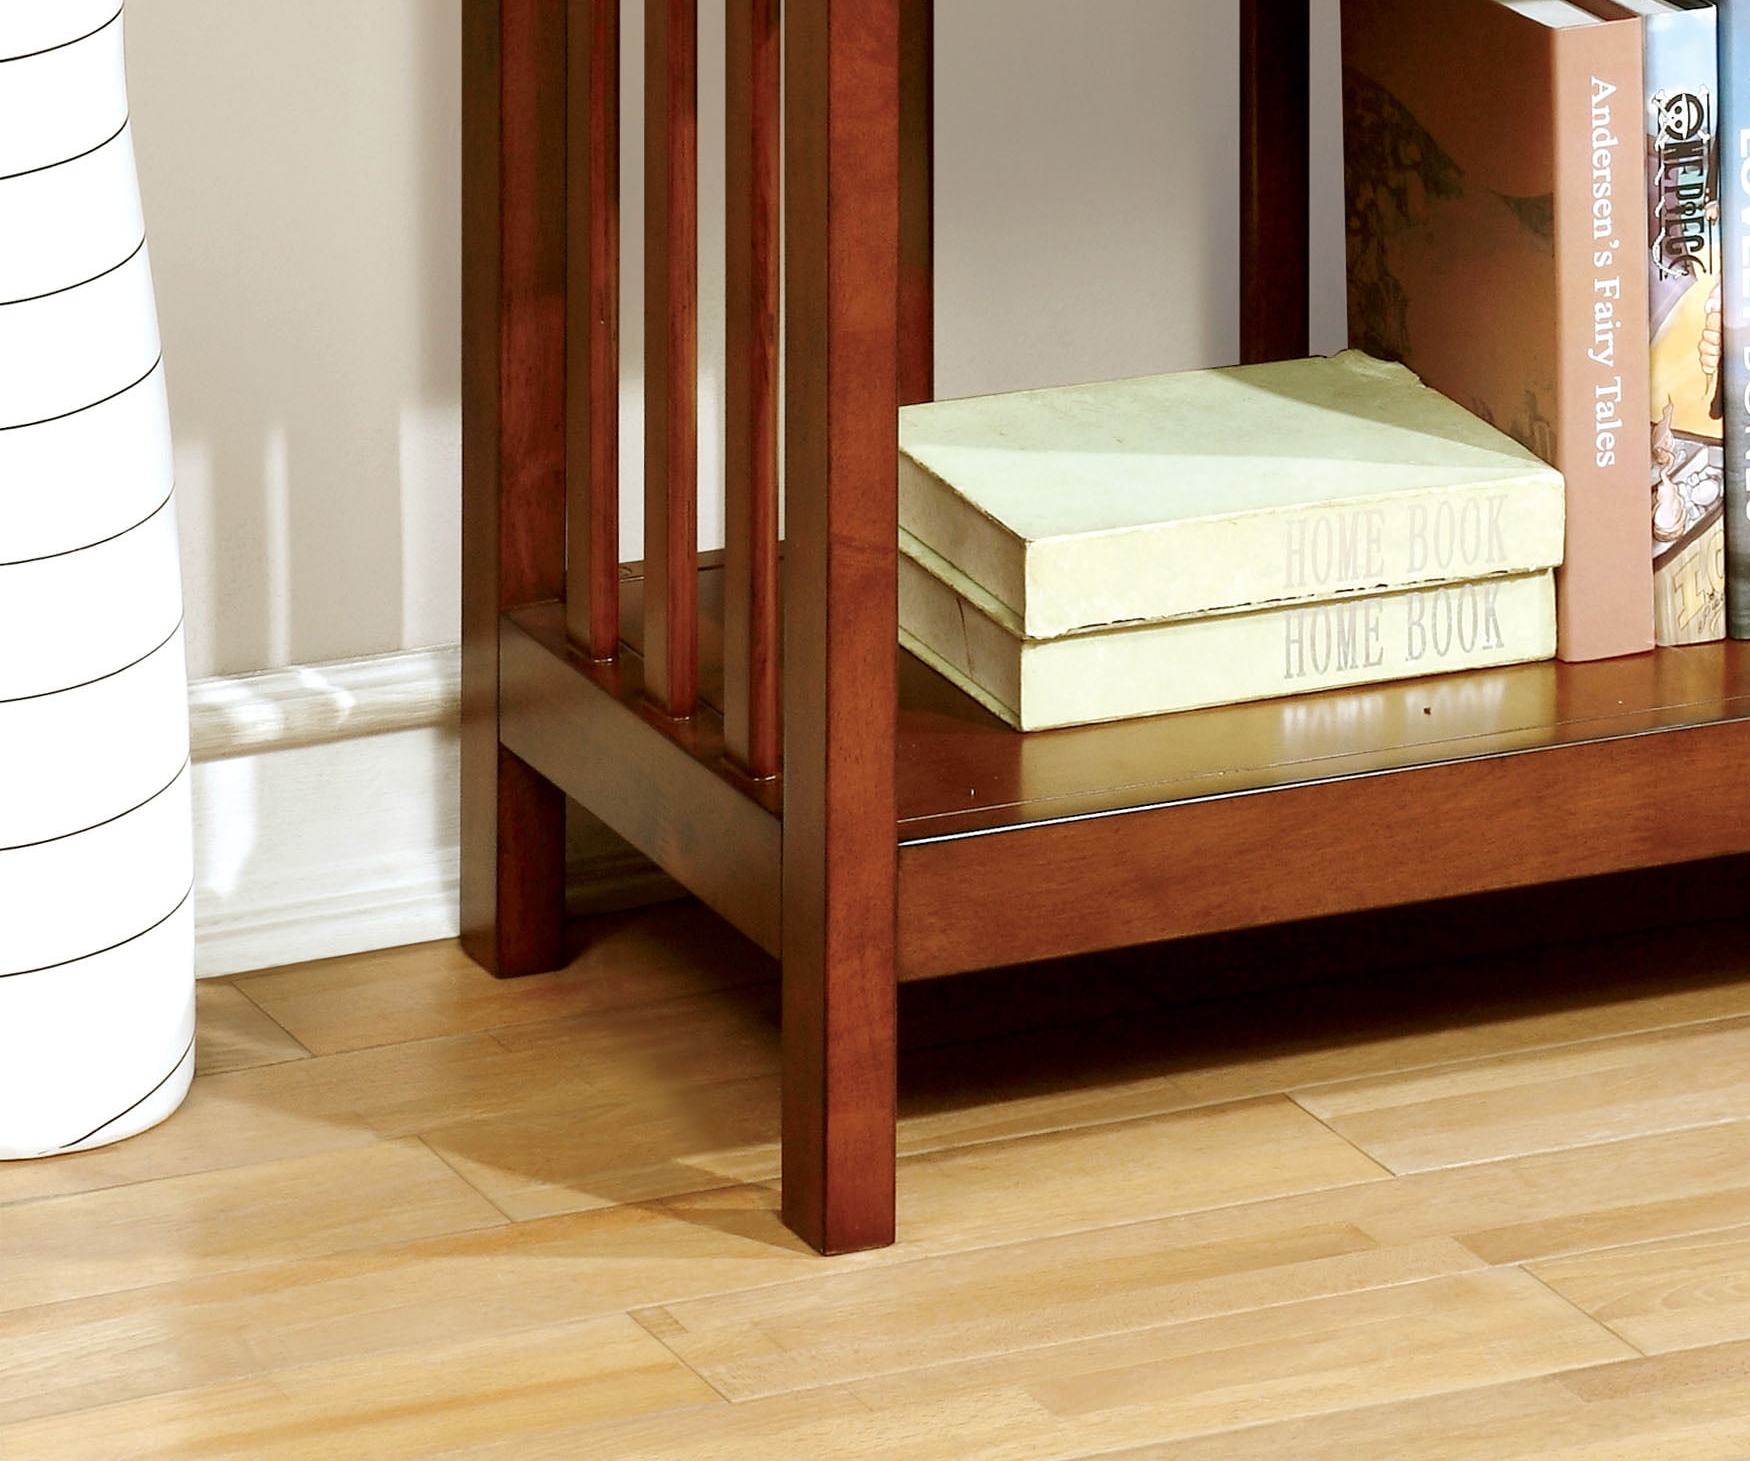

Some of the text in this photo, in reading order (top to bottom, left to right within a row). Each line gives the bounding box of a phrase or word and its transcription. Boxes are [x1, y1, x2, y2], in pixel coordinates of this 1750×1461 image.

[1588, 76, 1623, 468] Andersen's Fairy Tales
[1284, 494, 1509, 589] HOME BOOK
[1283, 580, 1505, 679] HOME BOOK
